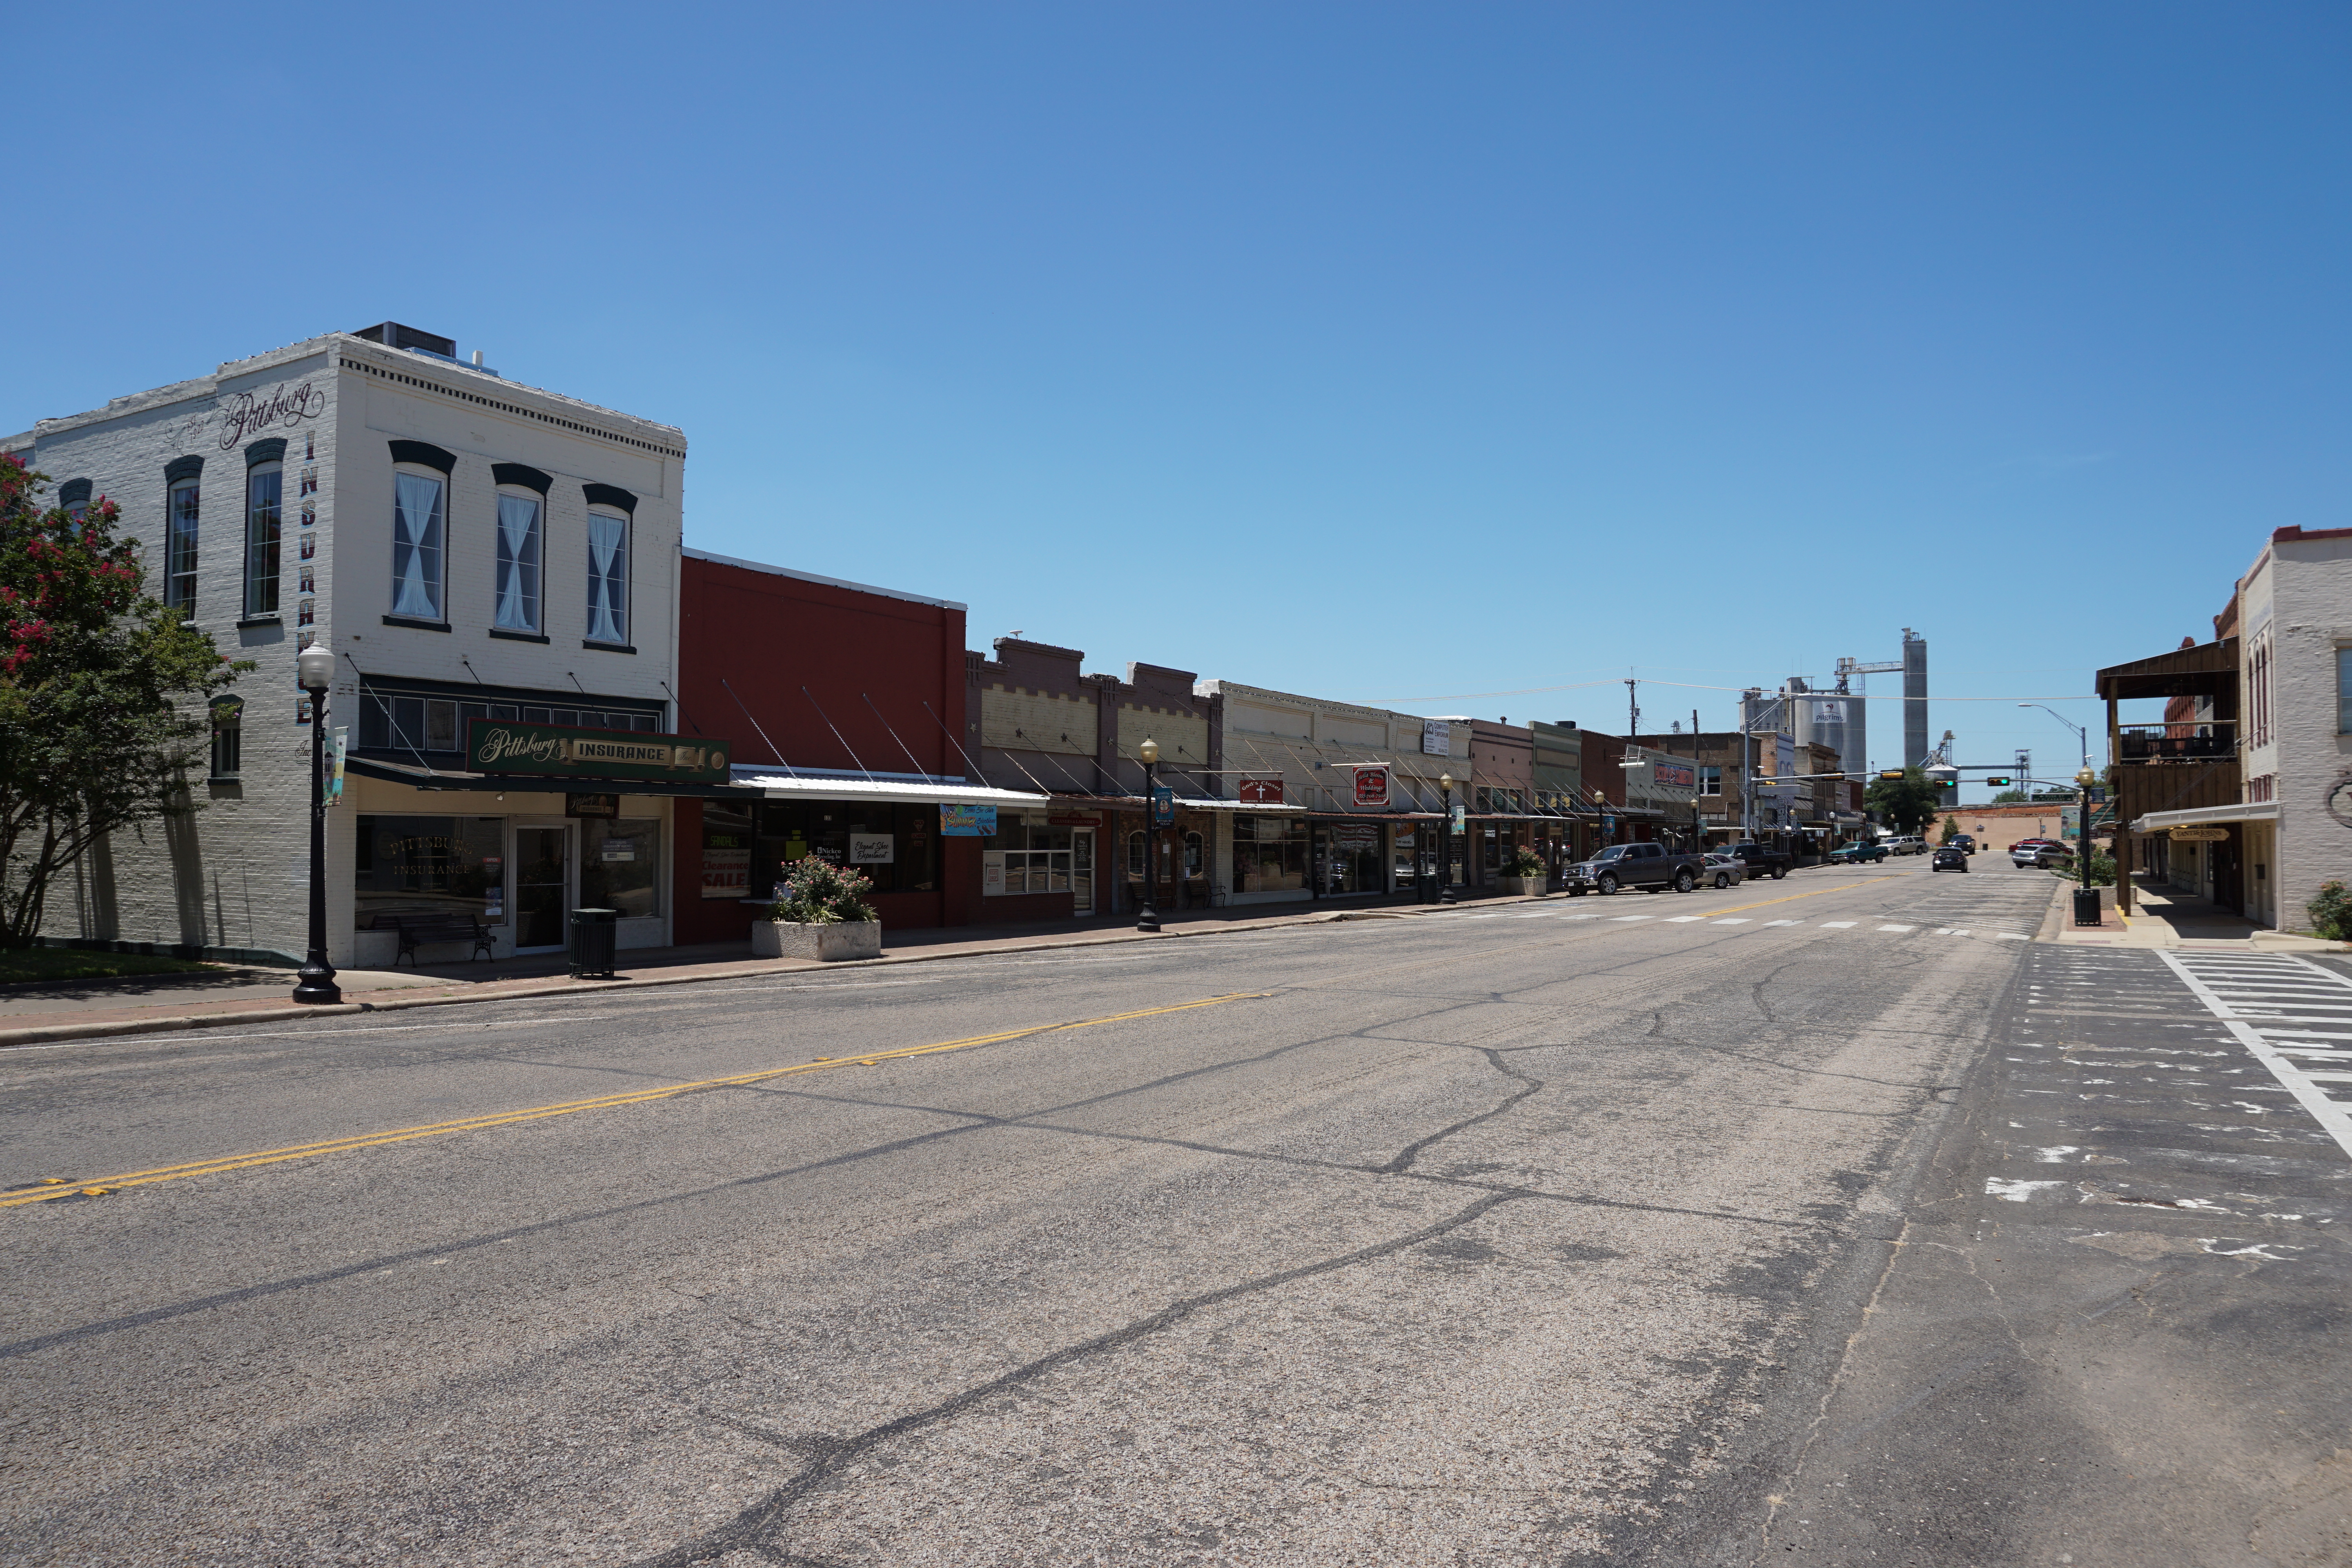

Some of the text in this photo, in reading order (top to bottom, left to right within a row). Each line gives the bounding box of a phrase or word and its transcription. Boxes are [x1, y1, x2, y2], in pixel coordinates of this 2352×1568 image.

[220, 382, 325, 450] Pittsburg
[296, 431, 318, 725] INSURANE
[1434, 722, 1448, 731] COMPUTER
[1435, 730, 1448, 738] EMPORIUM
[479, 728, 568, 763] Pittsburg
[579, 743, 665, 760] INSURANCE
[1358, 771, 1368, 781] Bella
[1242, 781, 1281, 792] God's Closet
[947, 815, 976, 828] SUMMER
[389, 836, 474, 855] PITTSBURG
[710, 835, 739, 847] SANDALS
[855, 841, 889, 852] Elegant Shoe
[857, 851, 889, 862] Department
[394, 865, 470, 875] INSURANCE
[702, 861, 749, 870] Clearance
[702, 873, 746, 888] SALE
